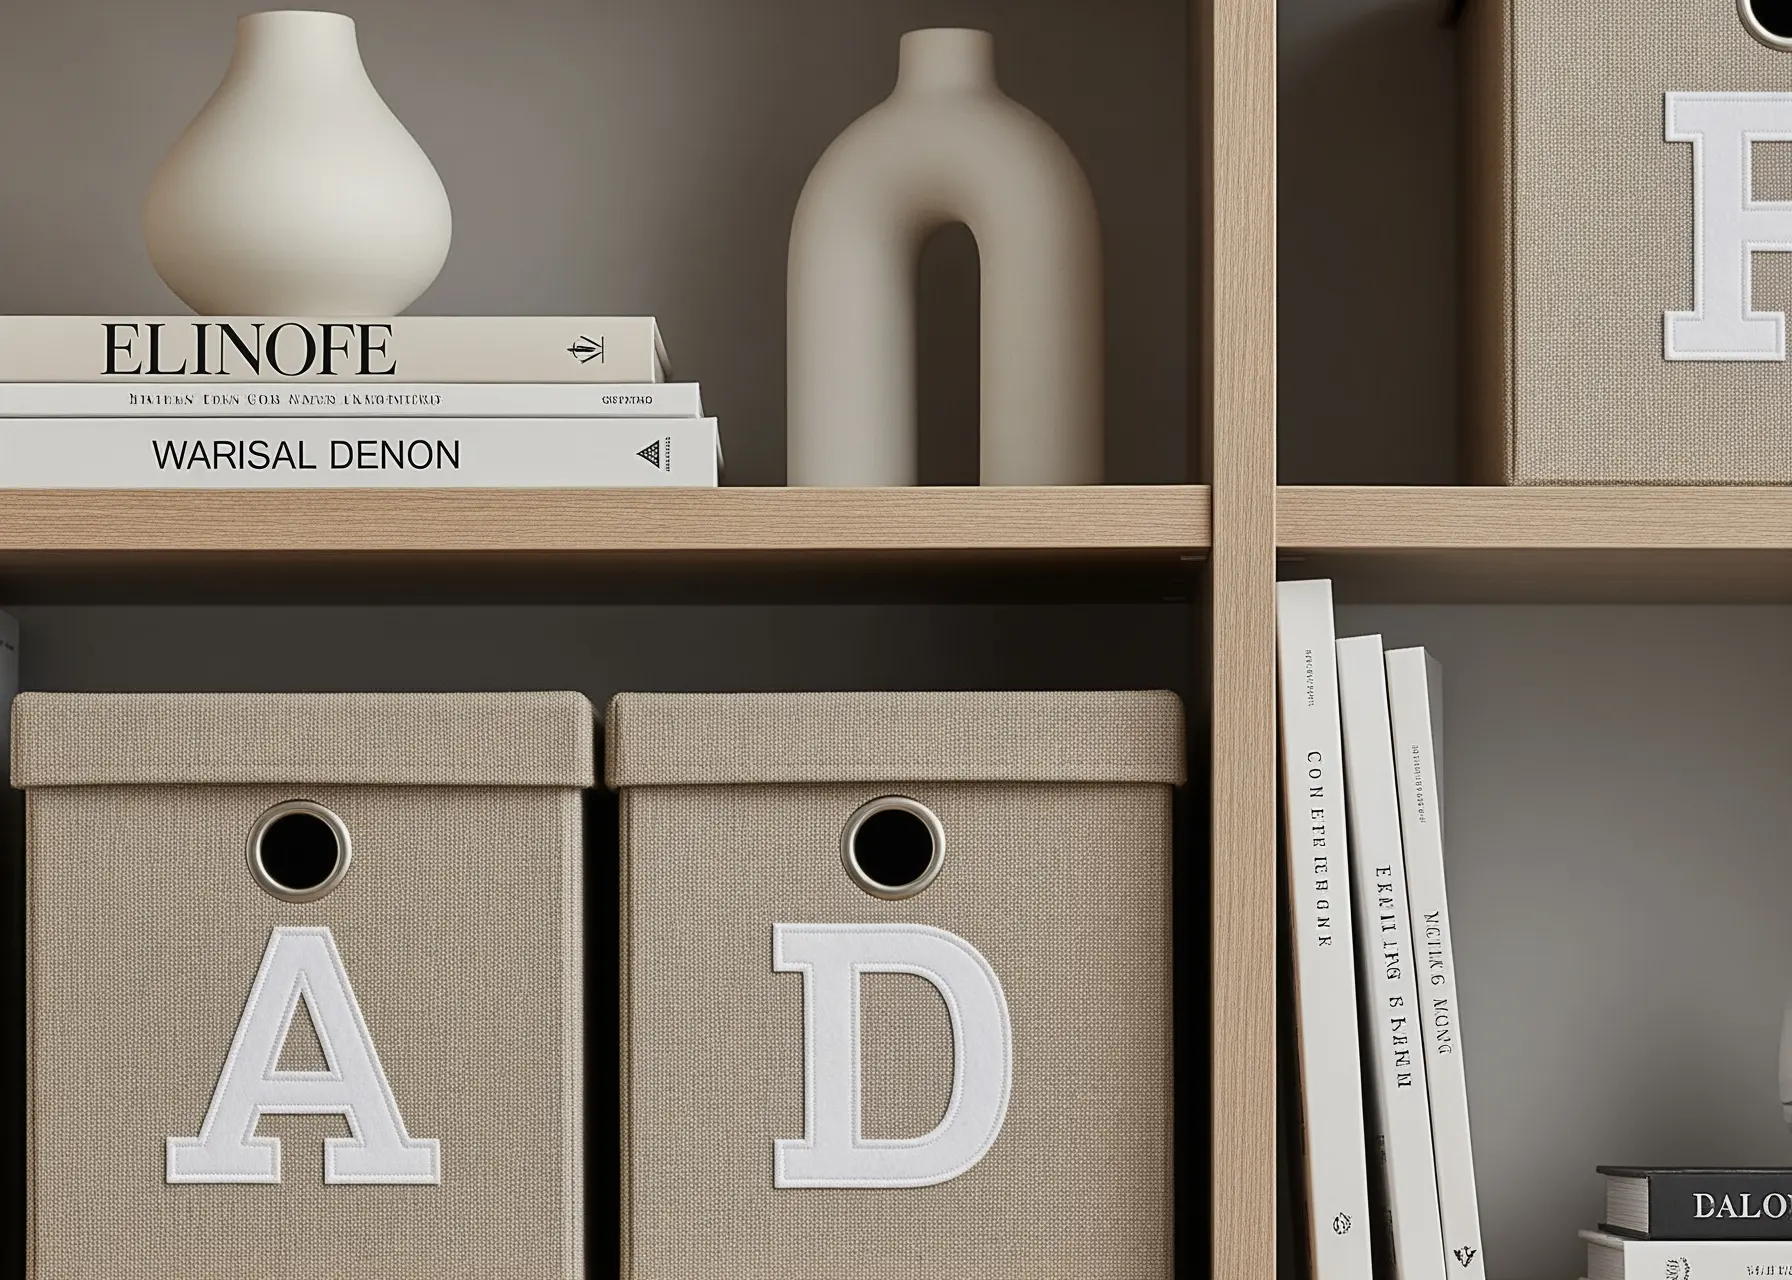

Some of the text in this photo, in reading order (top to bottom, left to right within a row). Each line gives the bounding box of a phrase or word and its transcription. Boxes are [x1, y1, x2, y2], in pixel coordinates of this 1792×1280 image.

[101, 322, 397, 376] ELINOFE
[152, 440, 461, 470] WARISAL DENON
[166, 925, 443, 1185] A
[772, 922, 1014, 1190] D
